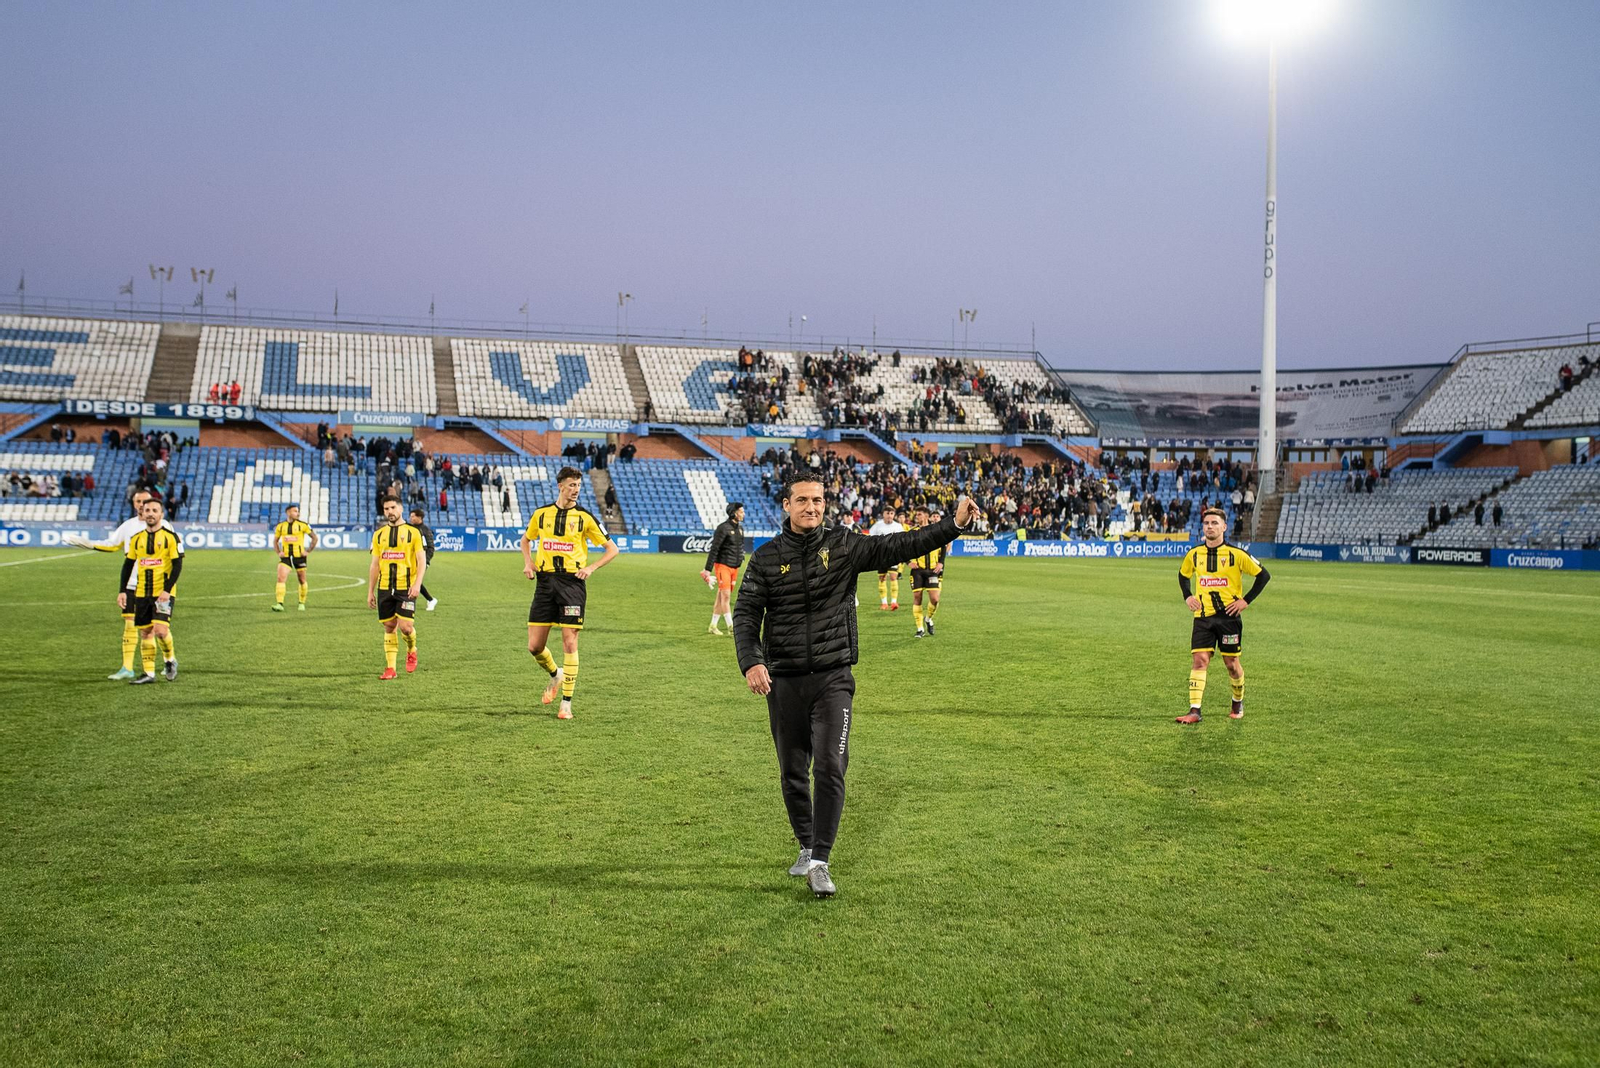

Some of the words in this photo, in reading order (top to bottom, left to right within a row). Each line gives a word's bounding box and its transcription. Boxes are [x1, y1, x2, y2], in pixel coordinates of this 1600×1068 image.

[1264, 200, 1275, 279] grupo
[1339, 372, 1415, 388] Motor
[76, 400, 156, 416] DESDE
[168, 404, 243, 419] 1889
[353, 412, 412, 426] Cruzcampo
[544, 542, 551, 550] el
[551, 542, 573, 551] jamón
[1024, 542, 1055, 556] Fresón
[1063, 543, 1078, 556] de
[1078, 544, 1107, 556] Palos
[1296, 547, 1323, 558] Planasa
[1372, 547, 1396, 557] RURAL
[1418, 550, 1482, 562] POWERADE
[1508, 553, 1564, 570] Cruzcampo
[839, 708, 849, 755] uhlsport
